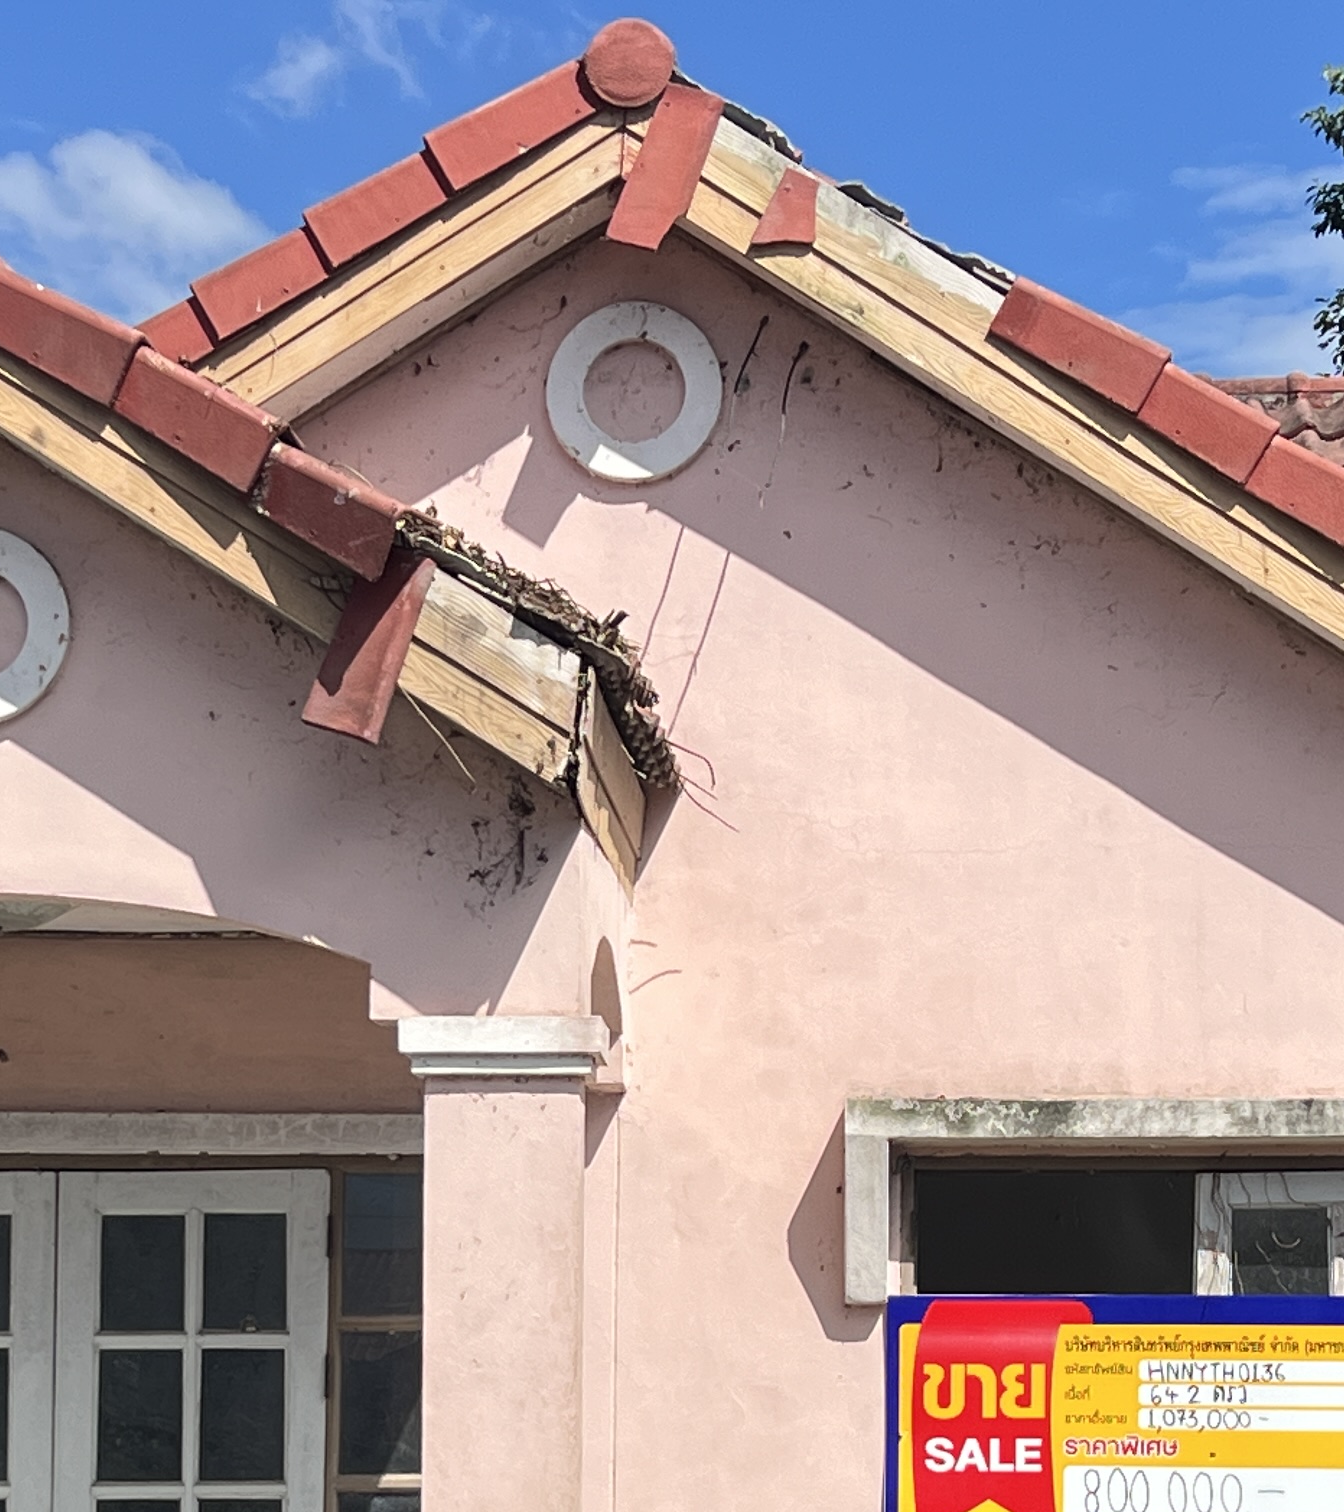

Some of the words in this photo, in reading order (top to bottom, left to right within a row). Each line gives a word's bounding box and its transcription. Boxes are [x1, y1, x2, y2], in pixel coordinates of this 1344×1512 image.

[1269, 1336, 1299, 1354] จำกัด
[922, 1363, 1046, 1420] ขาย
[924, 1436, 1044, 1473] SALE
[1064, 1435, 1179, 1456] ราคาพิเศษ
